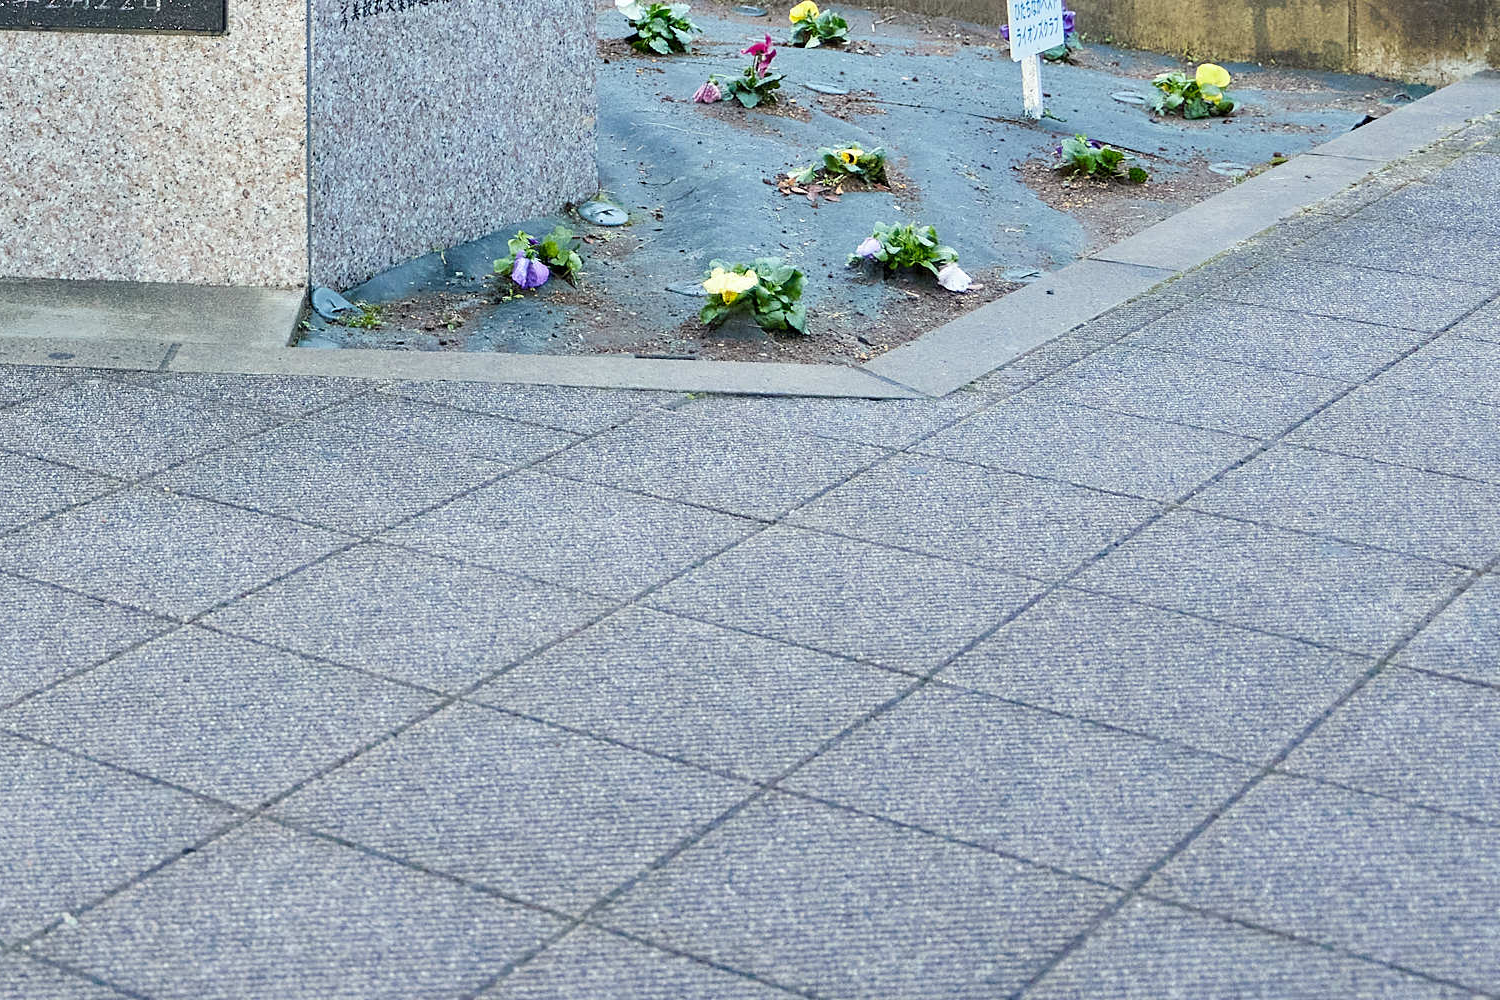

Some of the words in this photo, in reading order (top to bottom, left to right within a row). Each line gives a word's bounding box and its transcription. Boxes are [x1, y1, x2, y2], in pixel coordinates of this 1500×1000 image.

[1016, 15, 1059, 47] ライオンズクラブ
